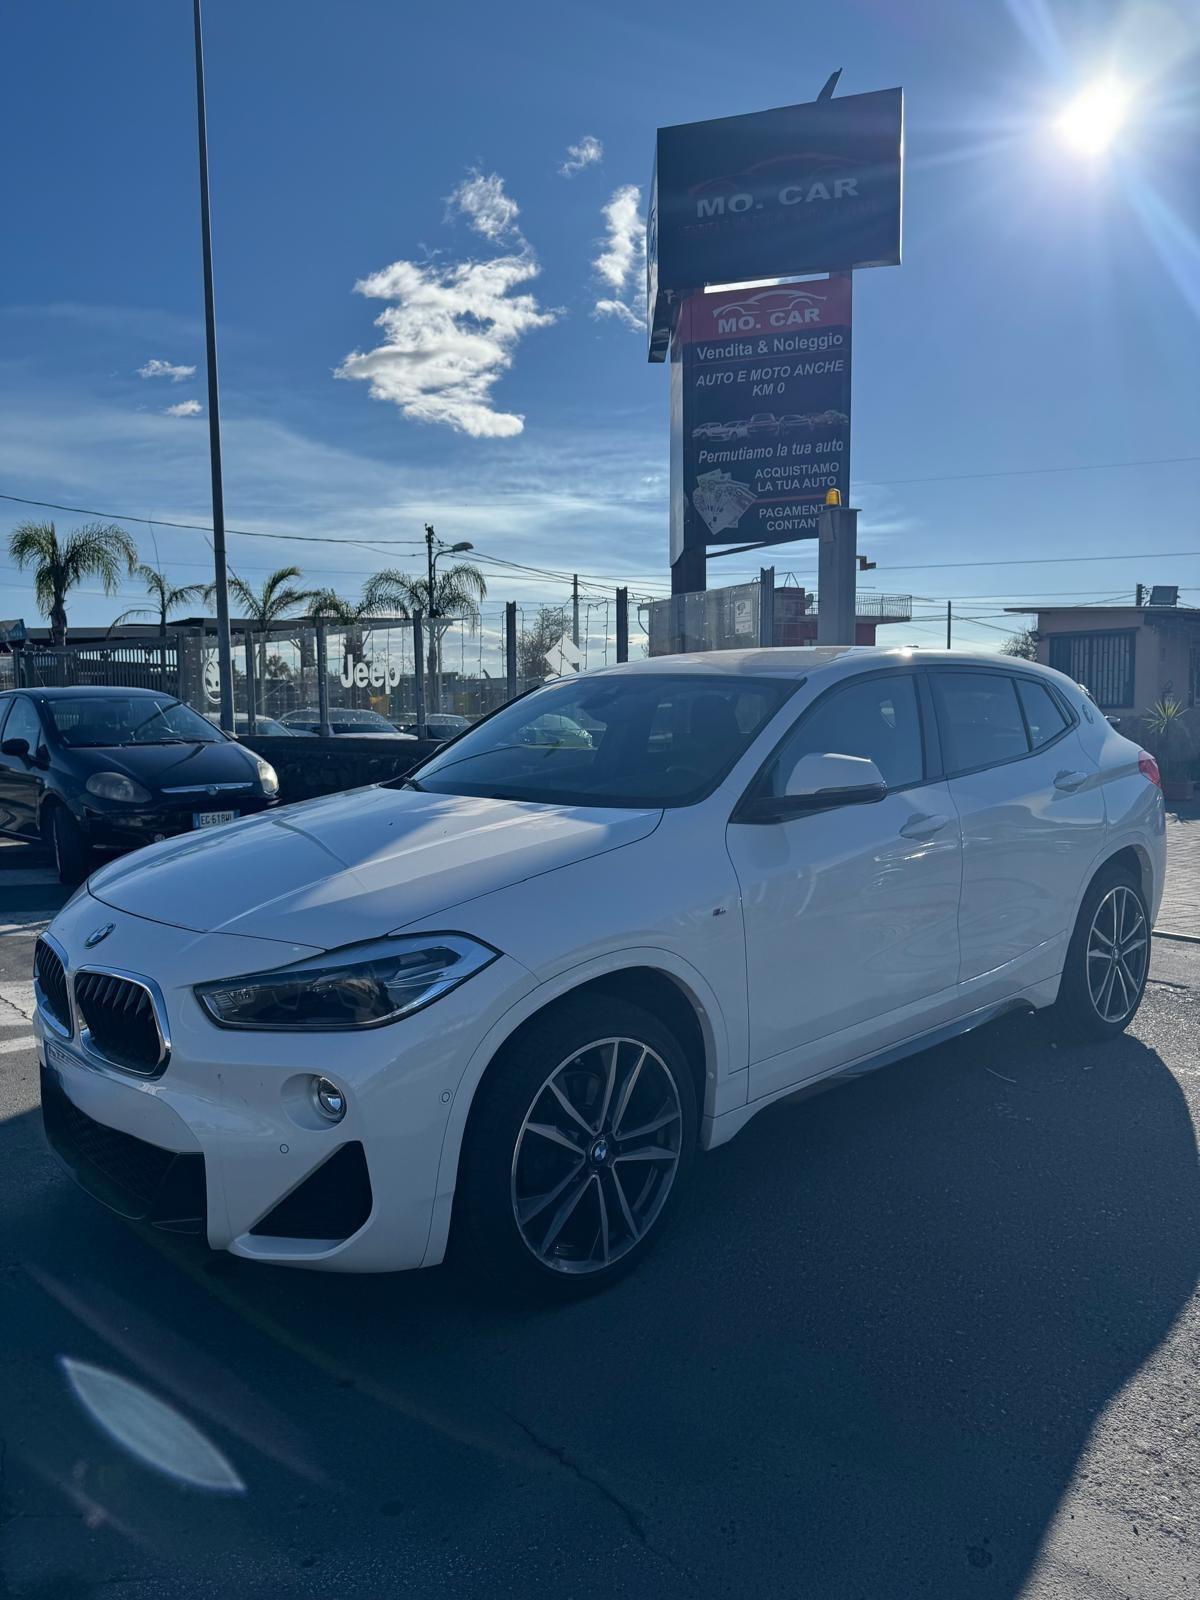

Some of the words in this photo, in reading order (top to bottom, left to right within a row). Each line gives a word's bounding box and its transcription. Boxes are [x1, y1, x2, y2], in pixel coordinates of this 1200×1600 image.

[697, 193, 764, 217] MO.
[779, 178, 859, 205] CAR
[718, 316, 761, 334] MO.
[770, 308, 821, 326] CAR
[697, 344, 753, 360] Vendita
[757, 340, 769, 353] &
[774, 333, 844, 351] Noleggio
[696, 372, 734, 387] AUTO
[737, 370, 748, 382] E
[750, 366, 791, 381] MOTO
[794, 360, 845, 376] ANCHE
[752, 383, 774, 396] KM
[777, 382, 786, 393] 0
[699, 446, 773, 463] Permutiamo
[776, 444, 788, 456] la
[792, 442, 812, 455] tua
[815, 438, 844, 453] auto
[755, 462, 840, 479] ACQUISTIAMO
[758, 481, 773, 492] LA
[776, 479, 800, 490] TUA
[802, 476, 837, 488] AUTO
[760, 504, 825, 518] PAGAMENT
[767, 517, 820, 531] CONTAN
[340, 654, 400, 694] Jeep
